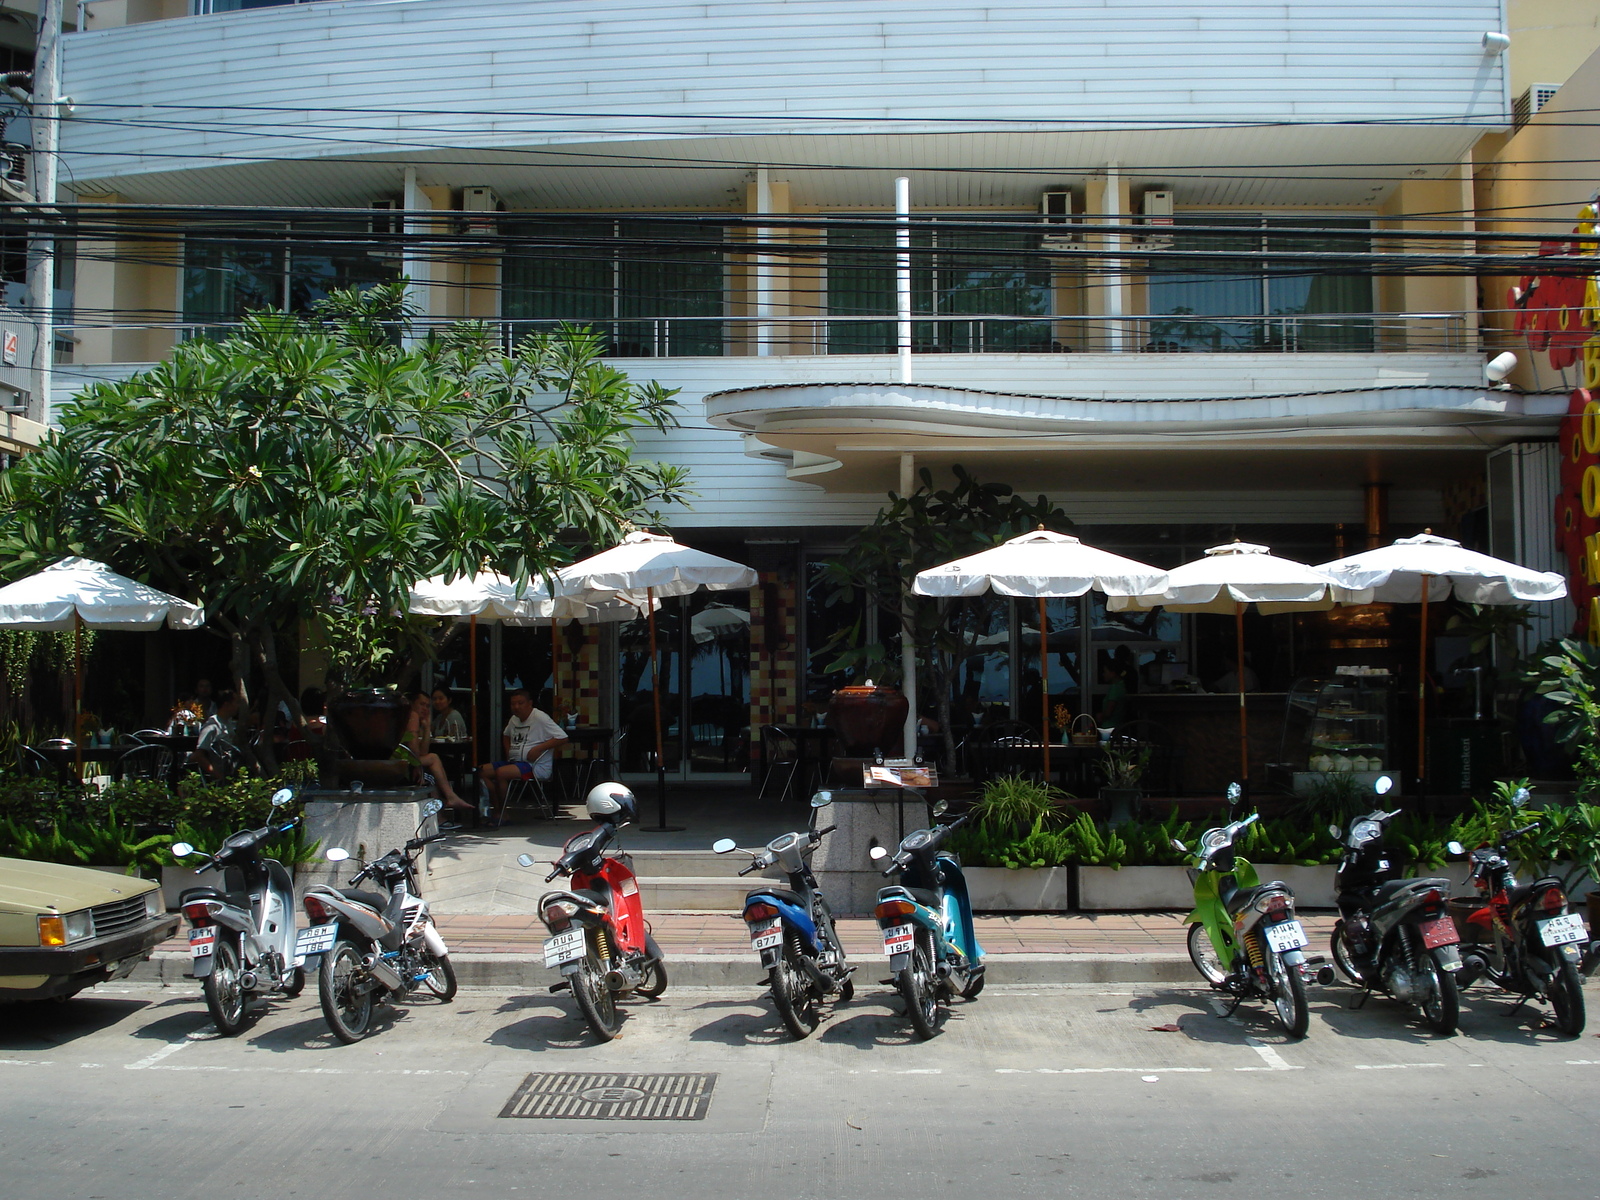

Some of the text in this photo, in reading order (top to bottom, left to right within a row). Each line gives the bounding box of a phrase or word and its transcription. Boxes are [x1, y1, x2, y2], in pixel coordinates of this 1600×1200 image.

[1461, 737, 1471, 789] Heineken
[757, 935, 776, 948] 877
[1553, 932, 1577, 943] 216
[197, 946, 208, 955] 18
[891, 942, 910, 953] 195
[1278, 939, 1301, 951] 618
[559, 951, 572, 961] 52
